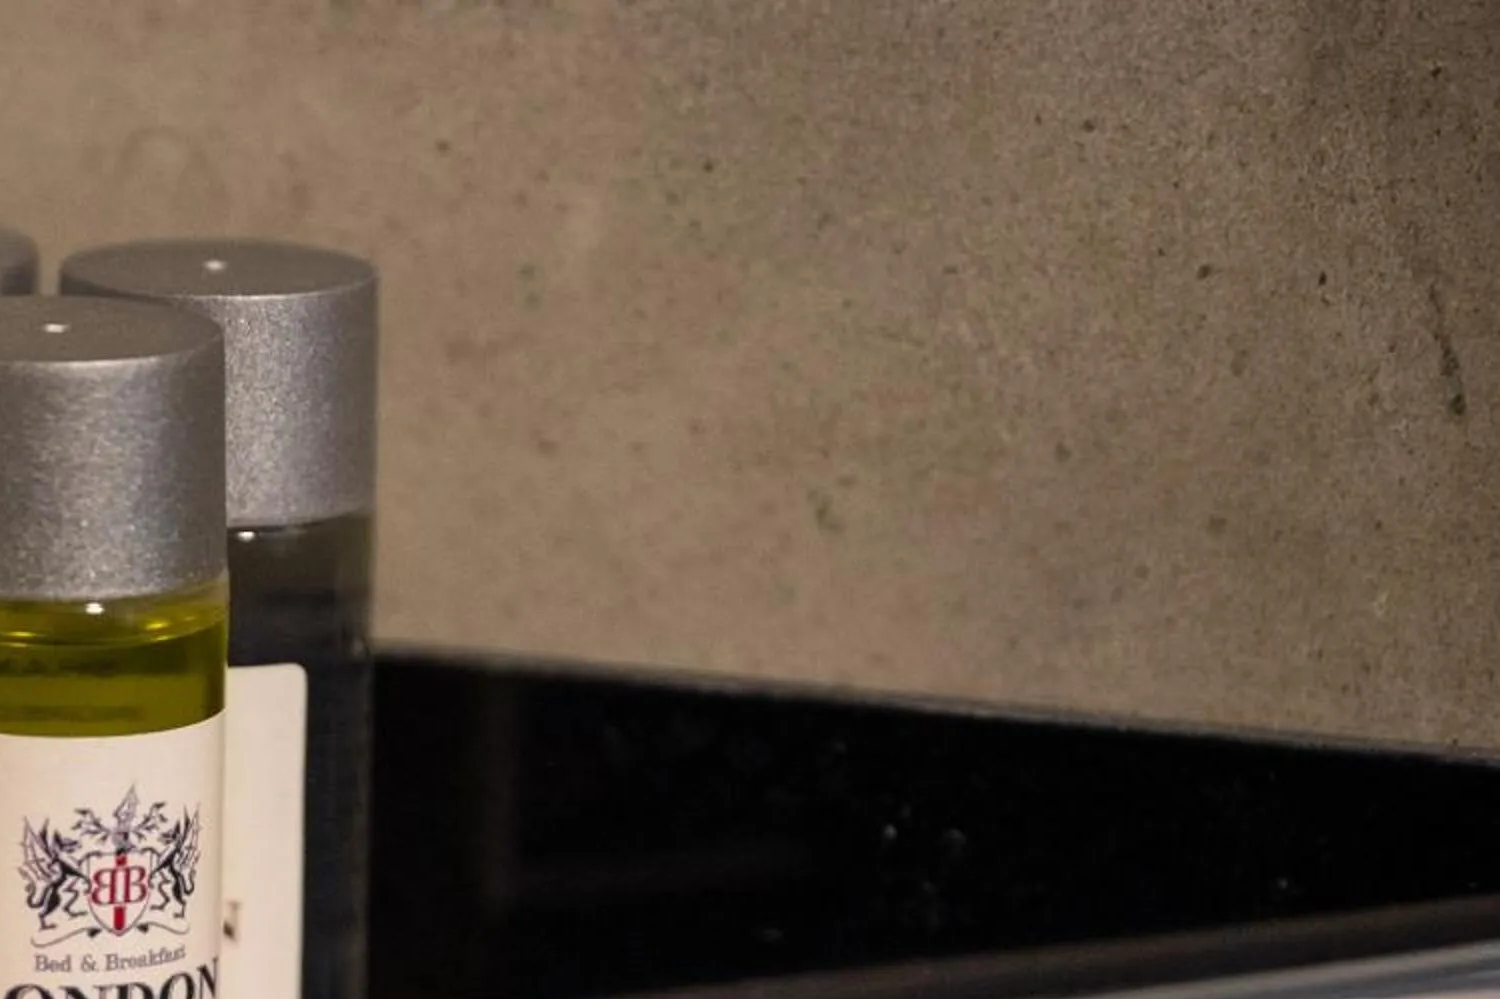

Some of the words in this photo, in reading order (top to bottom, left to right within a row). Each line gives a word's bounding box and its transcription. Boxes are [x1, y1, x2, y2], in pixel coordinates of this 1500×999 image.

[35, 954, 73, 974] Bed
[80, 955, 99, 973] &
[105, 945, 187, 973] Breakfast
